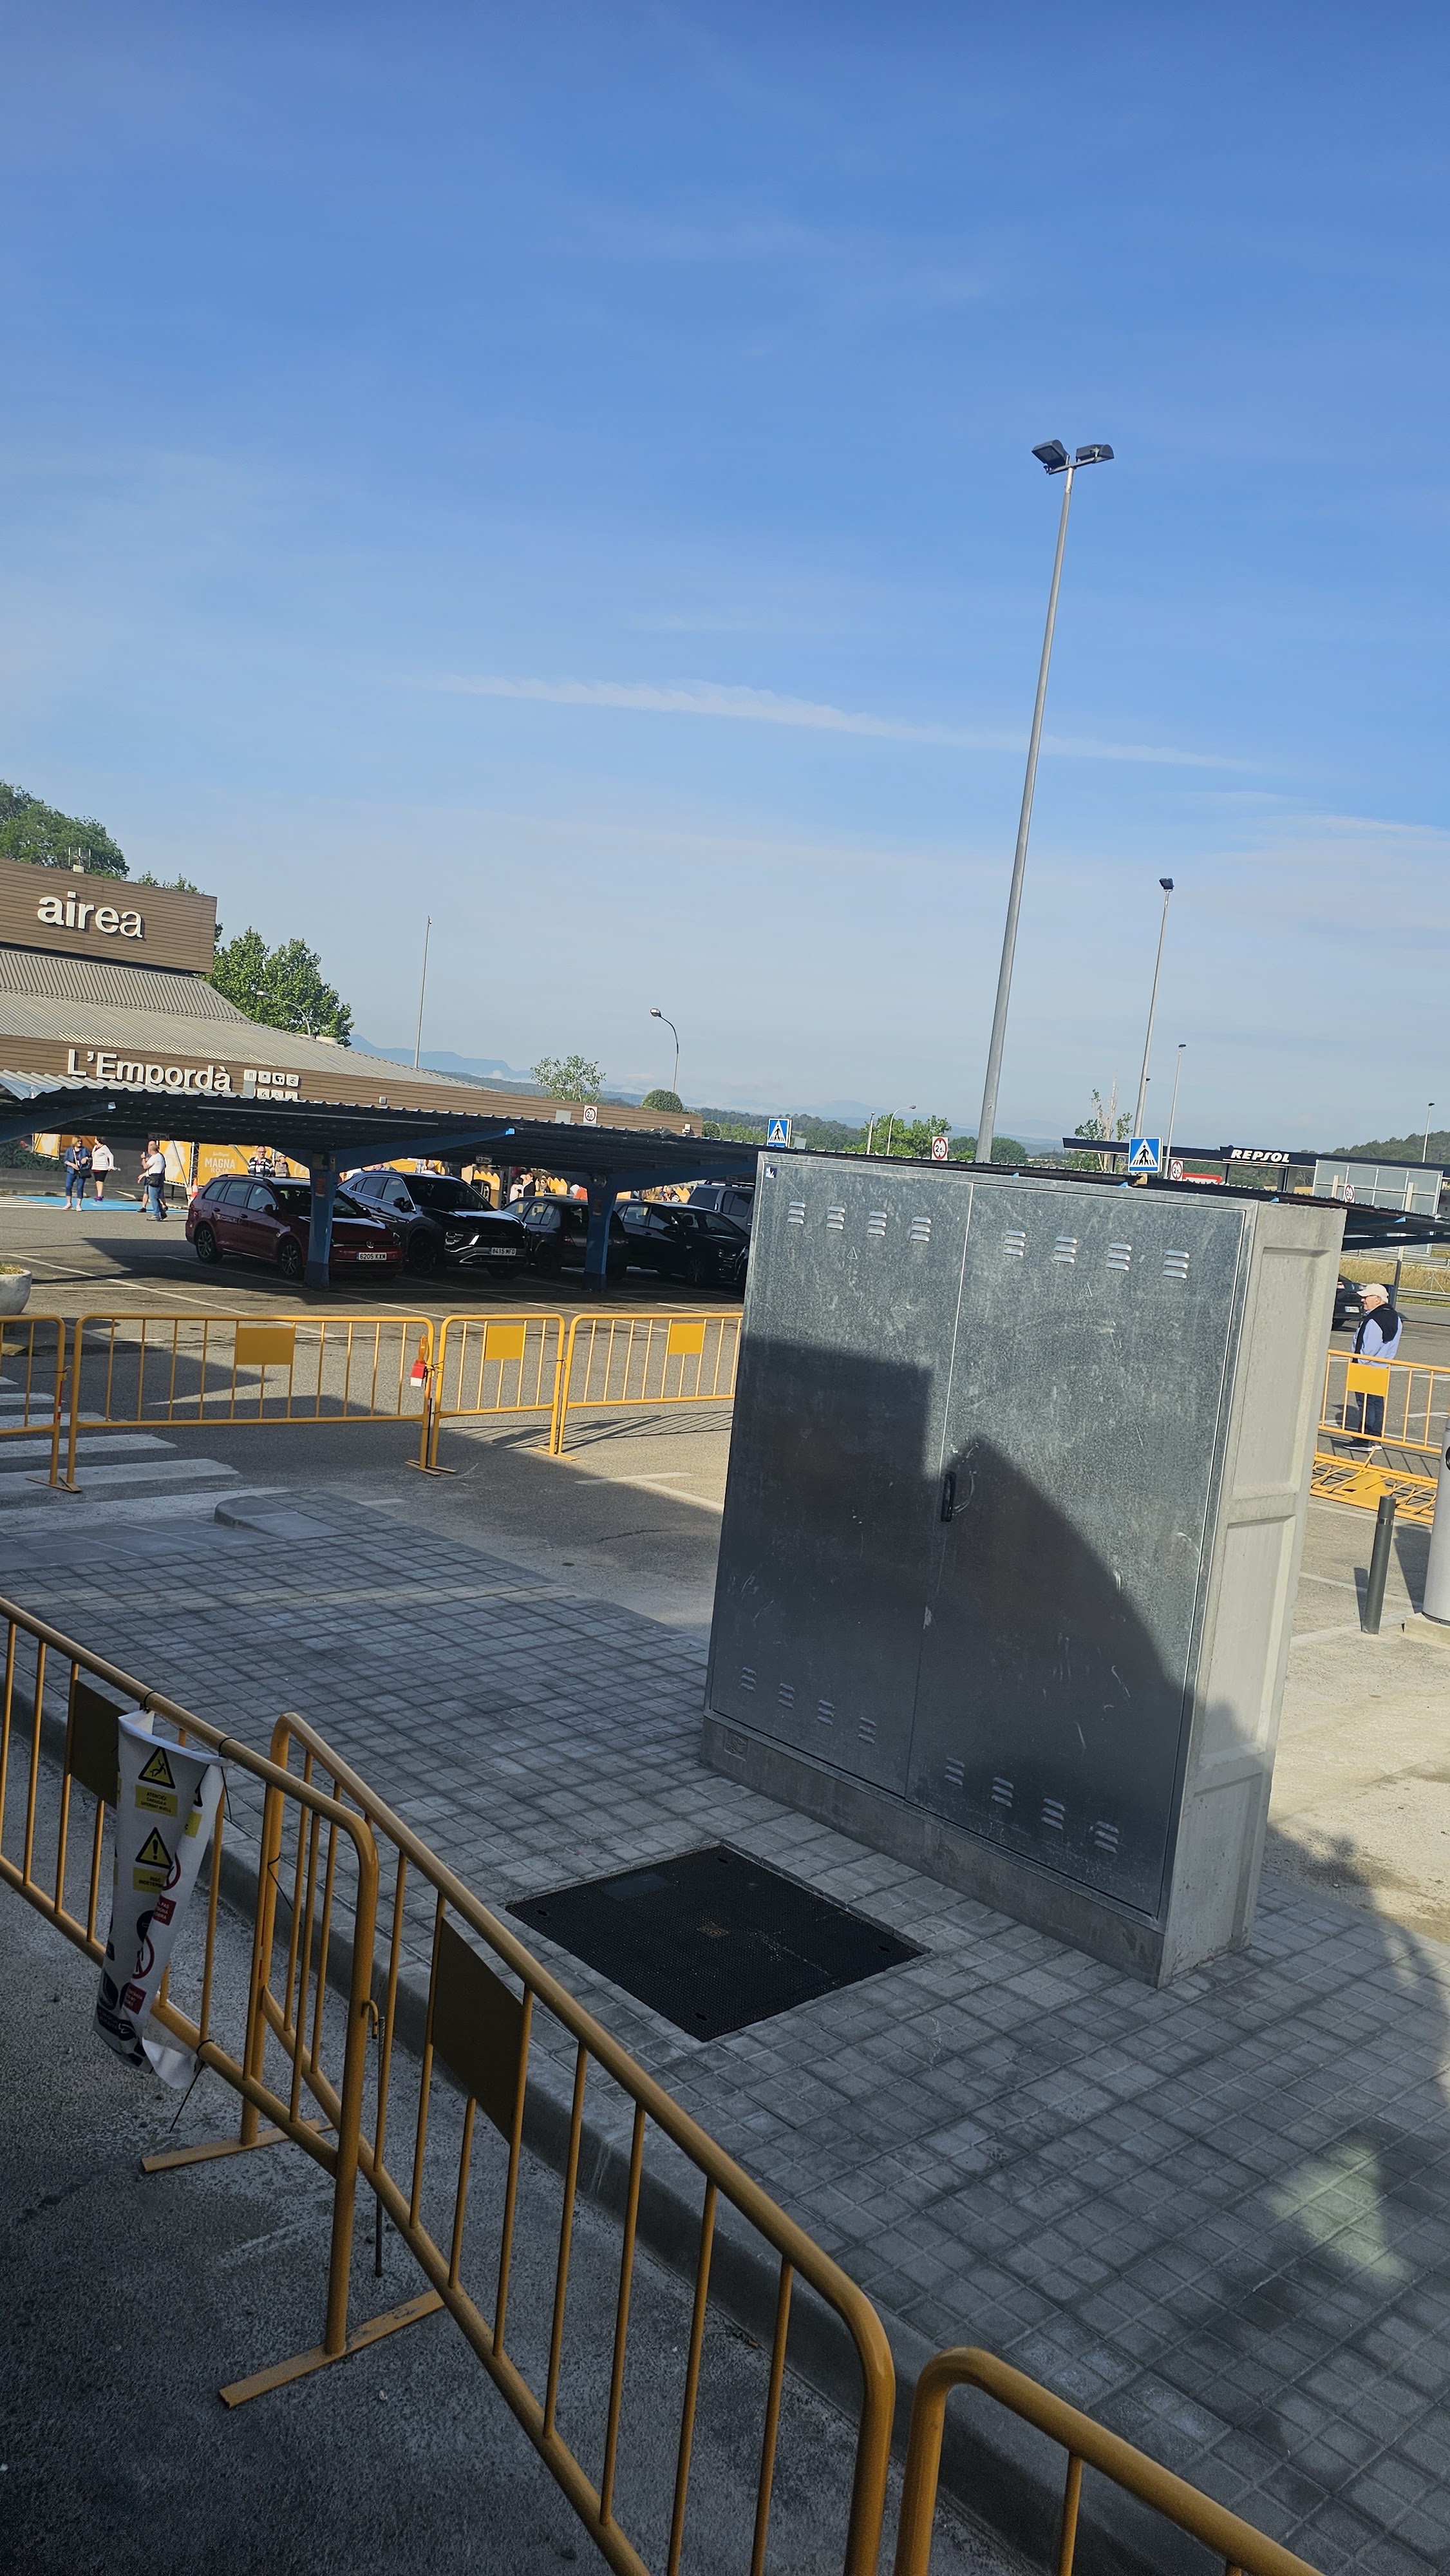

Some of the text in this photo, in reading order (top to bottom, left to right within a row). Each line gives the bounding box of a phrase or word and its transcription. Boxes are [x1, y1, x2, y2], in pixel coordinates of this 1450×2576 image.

[37, 891, 142, 938] airea
[1230, 1149, 1290, 1163] REPSOL
[205, 1157, 236, 1170] MAGNA
